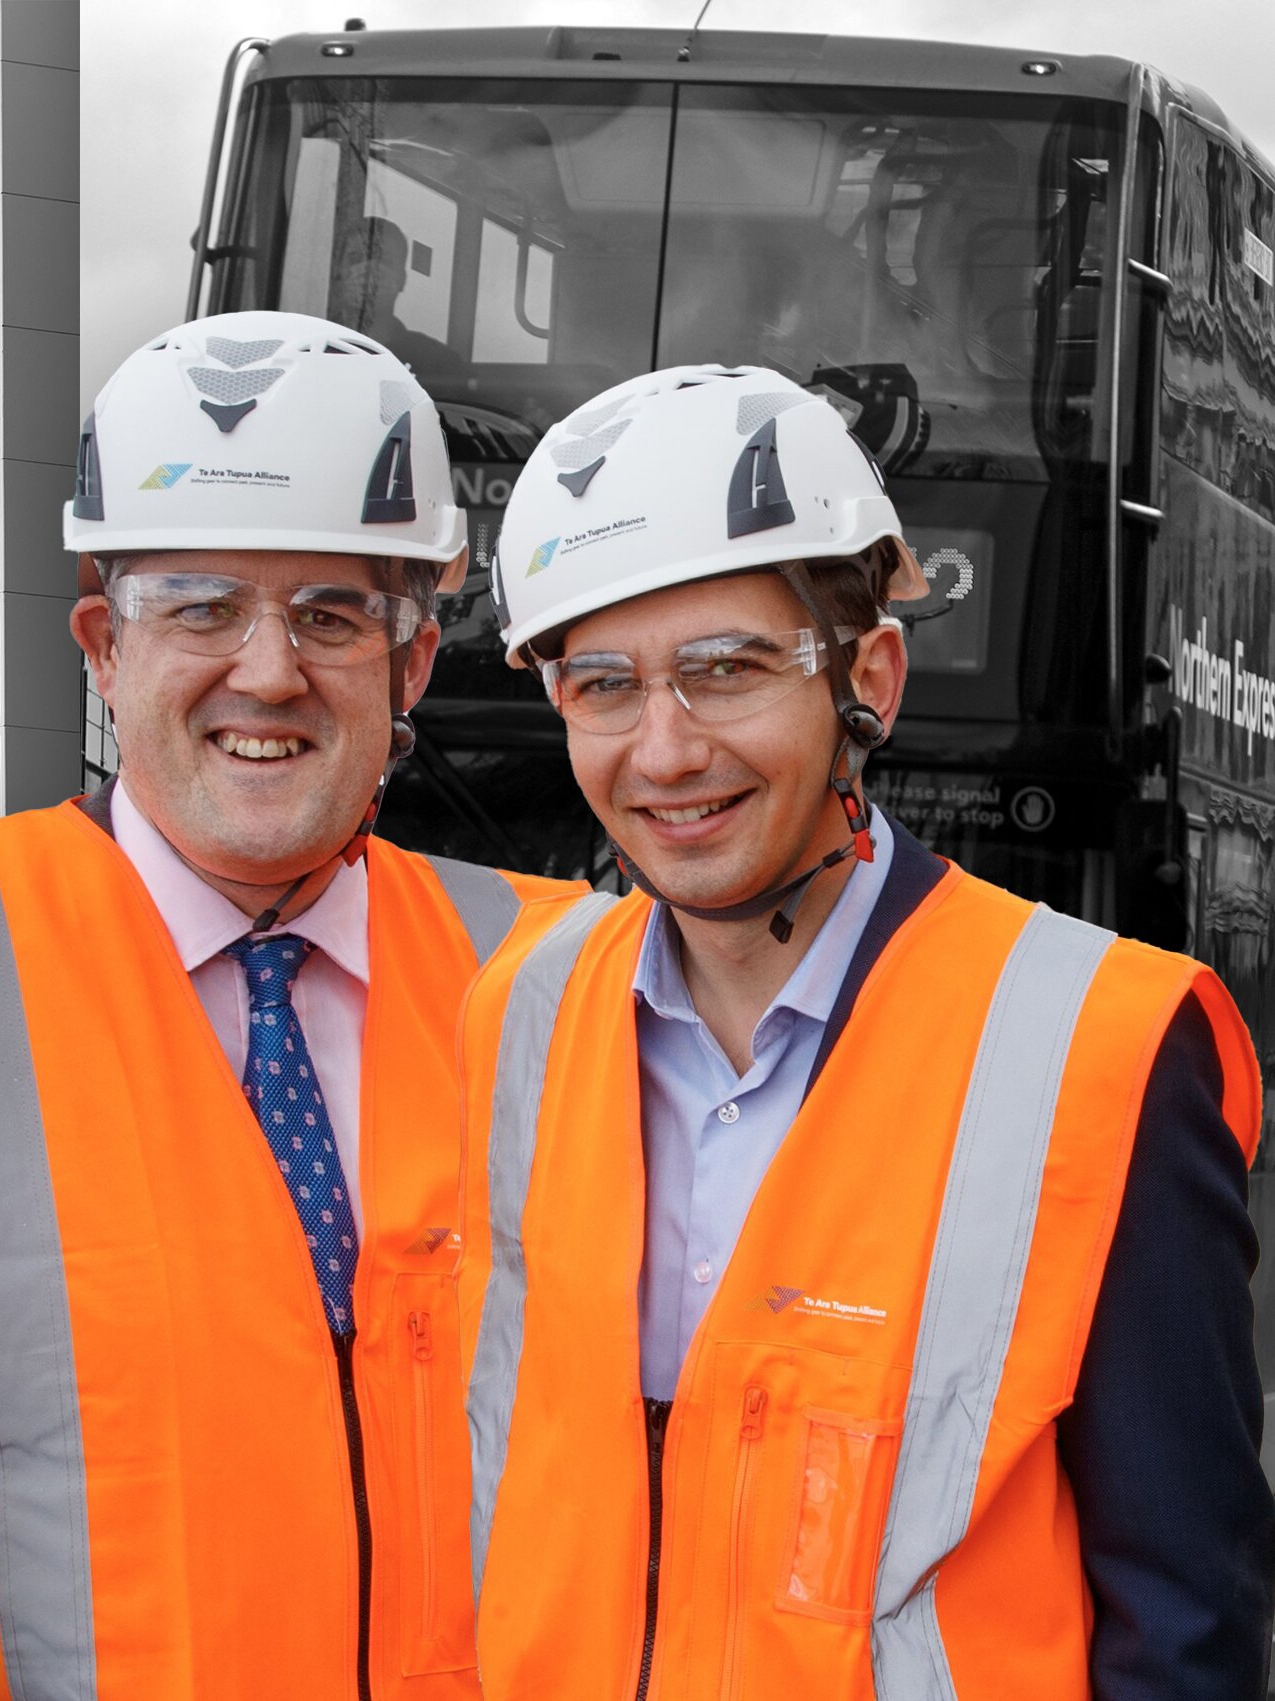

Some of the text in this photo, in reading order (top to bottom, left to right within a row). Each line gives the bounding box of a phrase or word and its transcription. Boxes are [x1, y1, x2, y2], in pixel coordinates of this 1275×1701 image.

[210, 469, 225, 477] Ara
[226, 469, 253, 478] Tupua
[254, 472, 290, 481] Alliance
[565, 516, 646, 546] Te Ara Tupua Alliance
[1168, 604, 1231, 721] Northern
[942, 784, 1001, 807] signal
[935, 805, 956, 822] to
[961, 808, 1005, 829] stop
[804, 1297, 815, 1306] Te
[815, 1299, 831, 1309] Ara
[858, 1306, 887, 1318] Alliance
